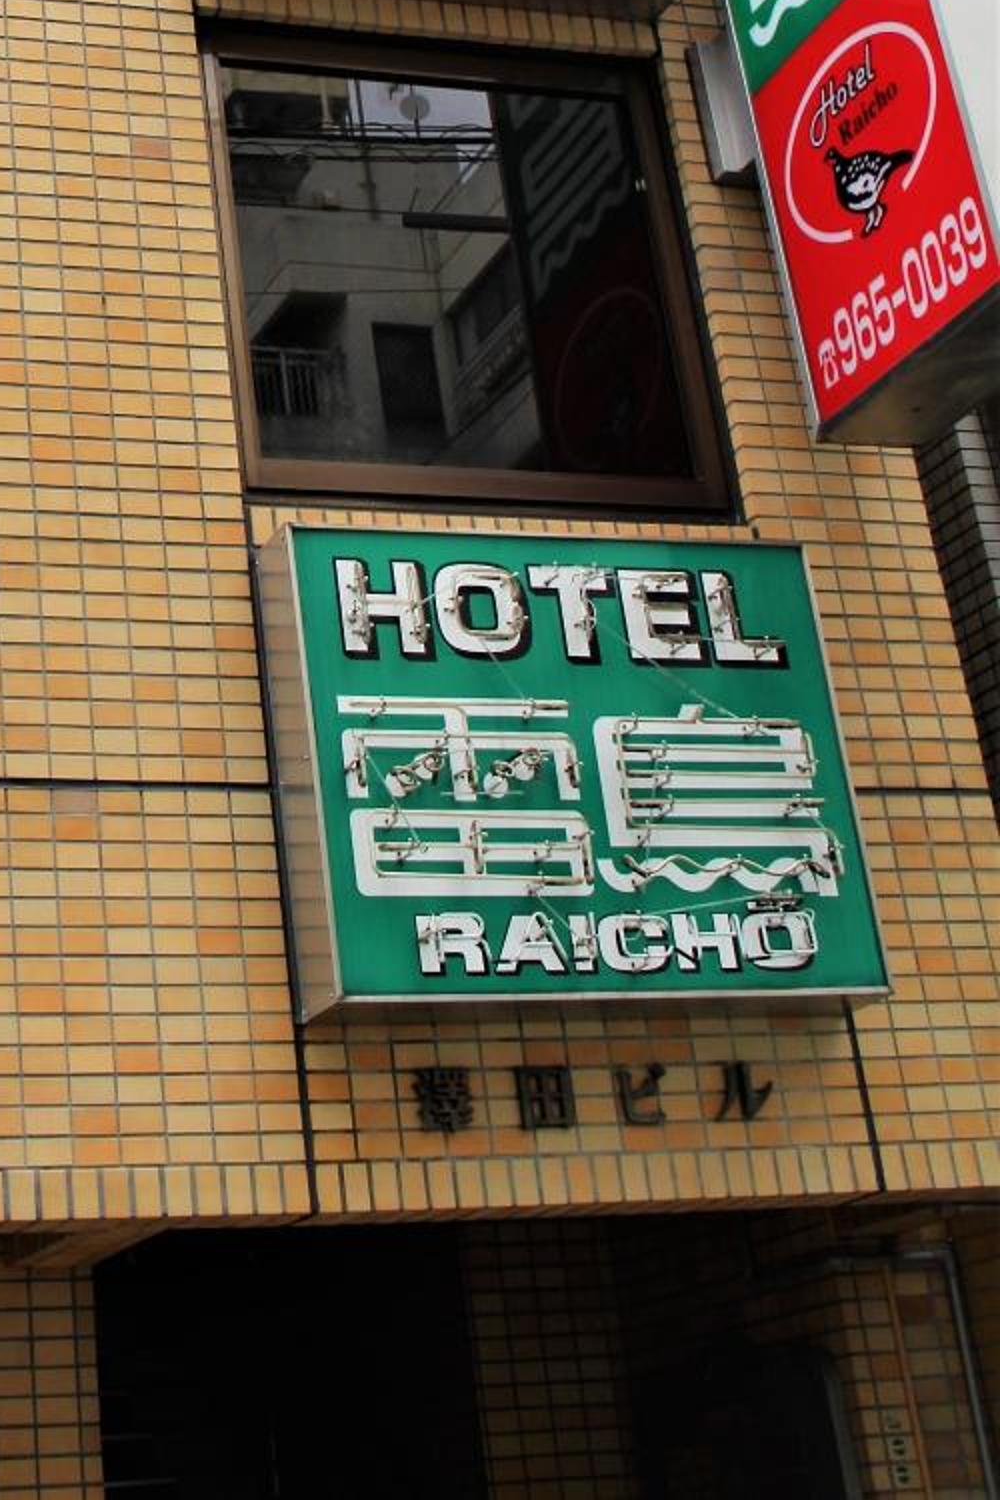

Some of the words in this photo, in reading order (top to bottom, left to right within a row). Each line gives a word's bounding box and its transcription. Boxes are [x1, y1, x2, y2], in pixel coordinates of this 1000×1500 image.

[809, 38, 876, 148] Hotel
[837, 82, 898, 146] Raicho
[333, 556, 790, 668] HOTEL
[337, 695, 840, 897] 雷鳥
